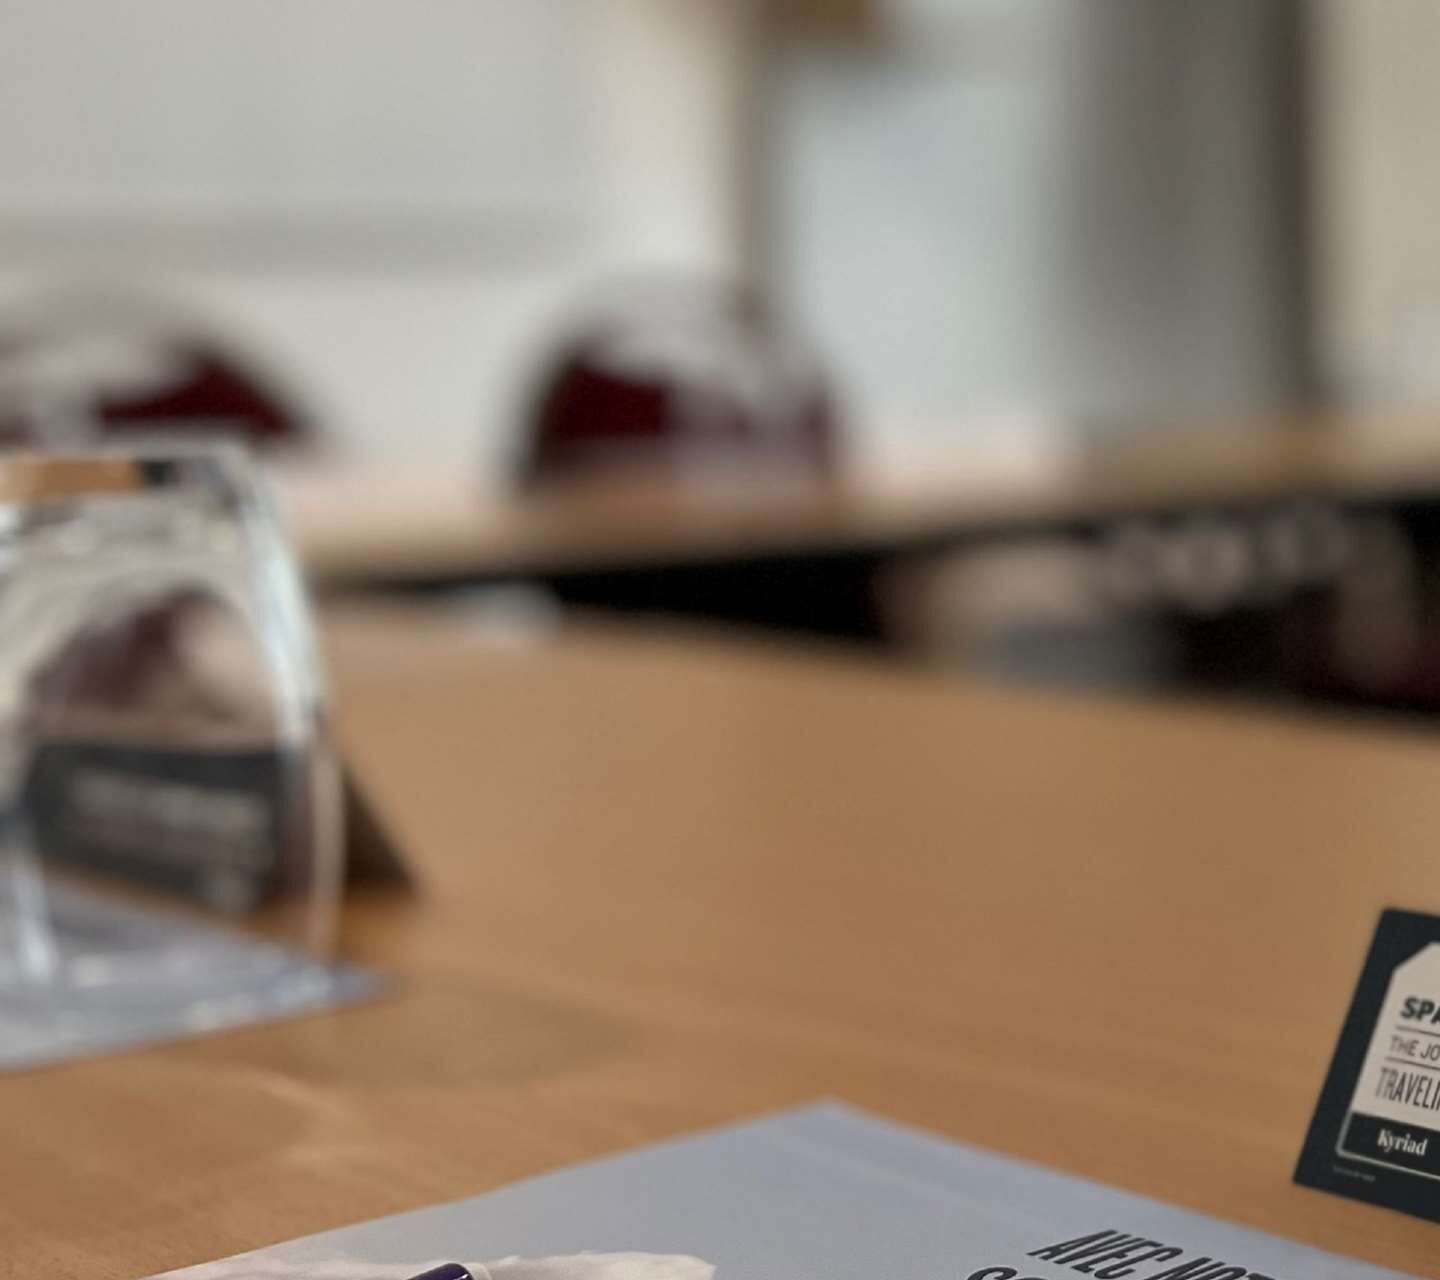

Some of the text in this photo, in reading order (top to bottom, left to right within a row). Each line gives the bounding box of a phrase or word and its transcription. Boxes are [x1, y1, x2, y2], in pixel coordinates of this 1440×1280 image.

[1389, 1034, 1418, 1057] THE
[1377, 1128, 1428, 1156] Kyriad
[1027, 1228, 1180, 1280] AVEC
